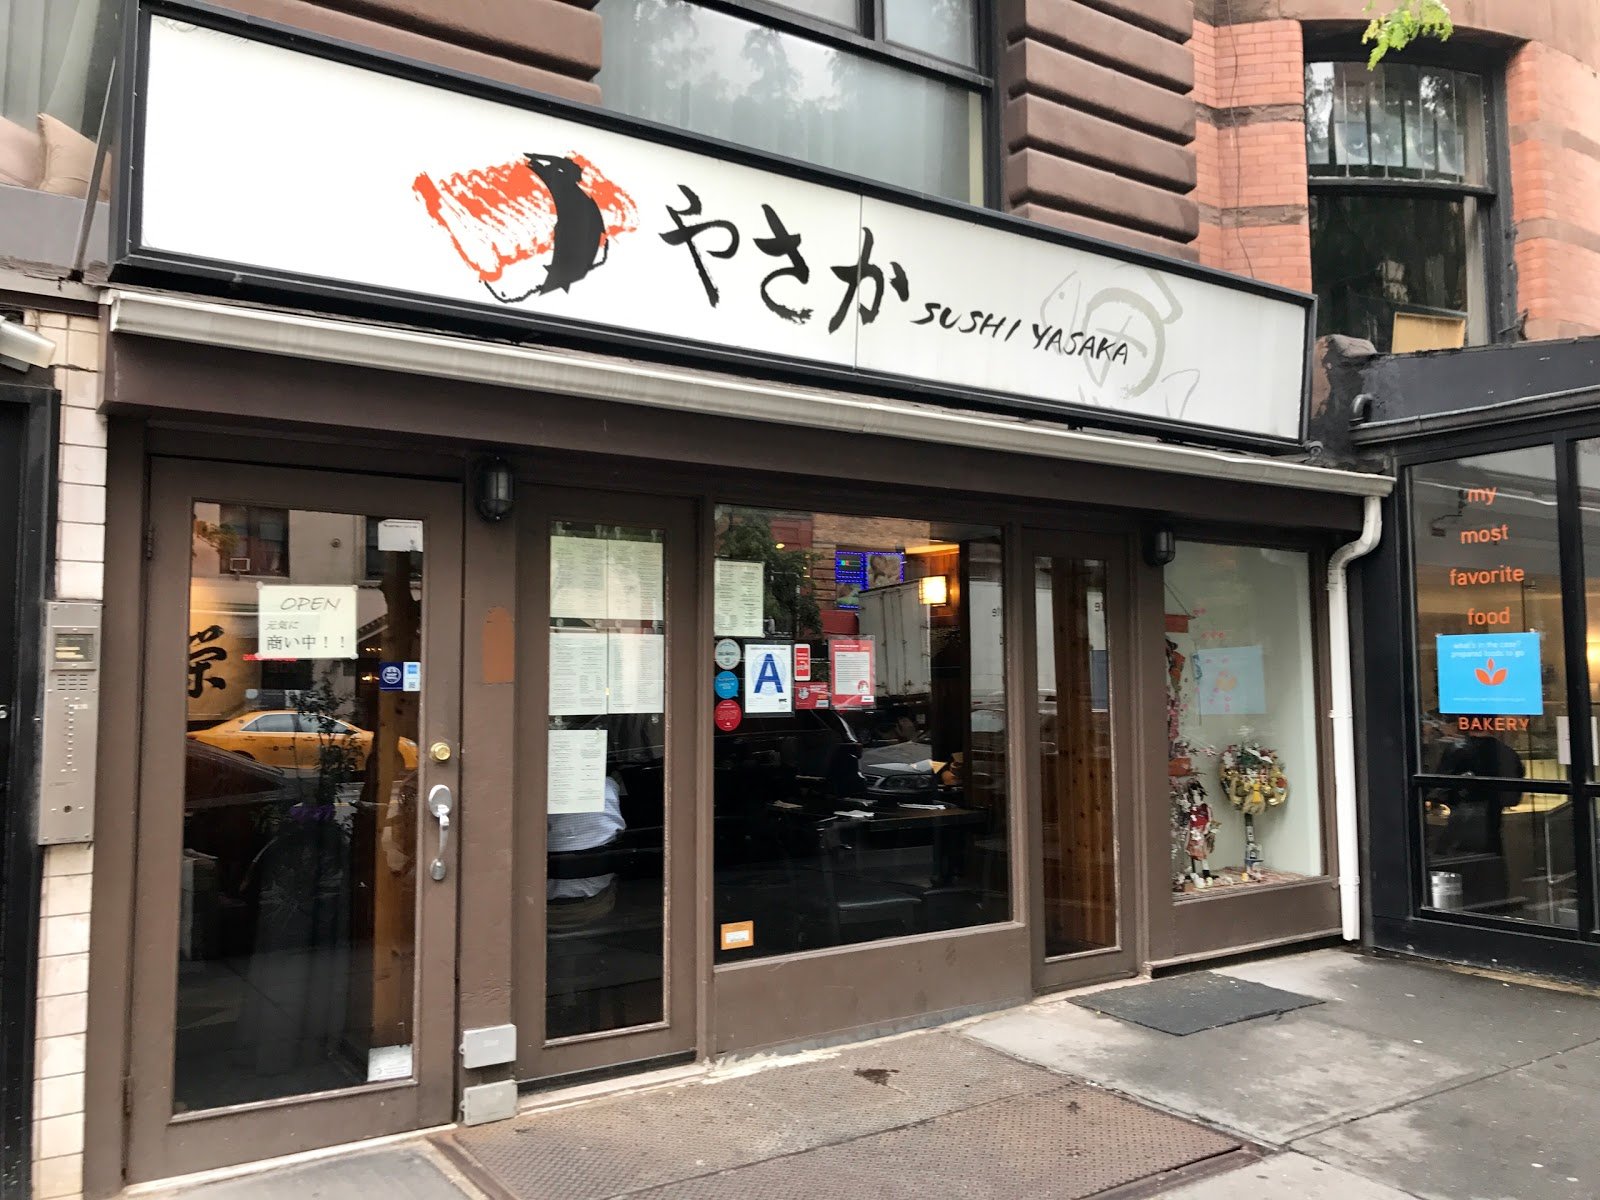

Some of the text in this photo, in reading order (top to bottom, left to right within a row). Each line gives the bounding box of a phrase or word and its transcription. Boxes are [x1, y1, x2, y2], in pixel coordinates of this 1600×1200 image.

[657, 184, 909, 335] やさか
[910, 302, 1128, 365] SUSHI YASAKA
[1467, 487, 1497, 505] my
[1460, 524, 1509, 545] most
[1450, 565, 1525, 586] favorite
[280, 597, 341, 611] OPEN
[1467, 606, 1511, 625] food
[753, 653, 784, 693] A
[1458, 717, 1530, 731] BAKERY
